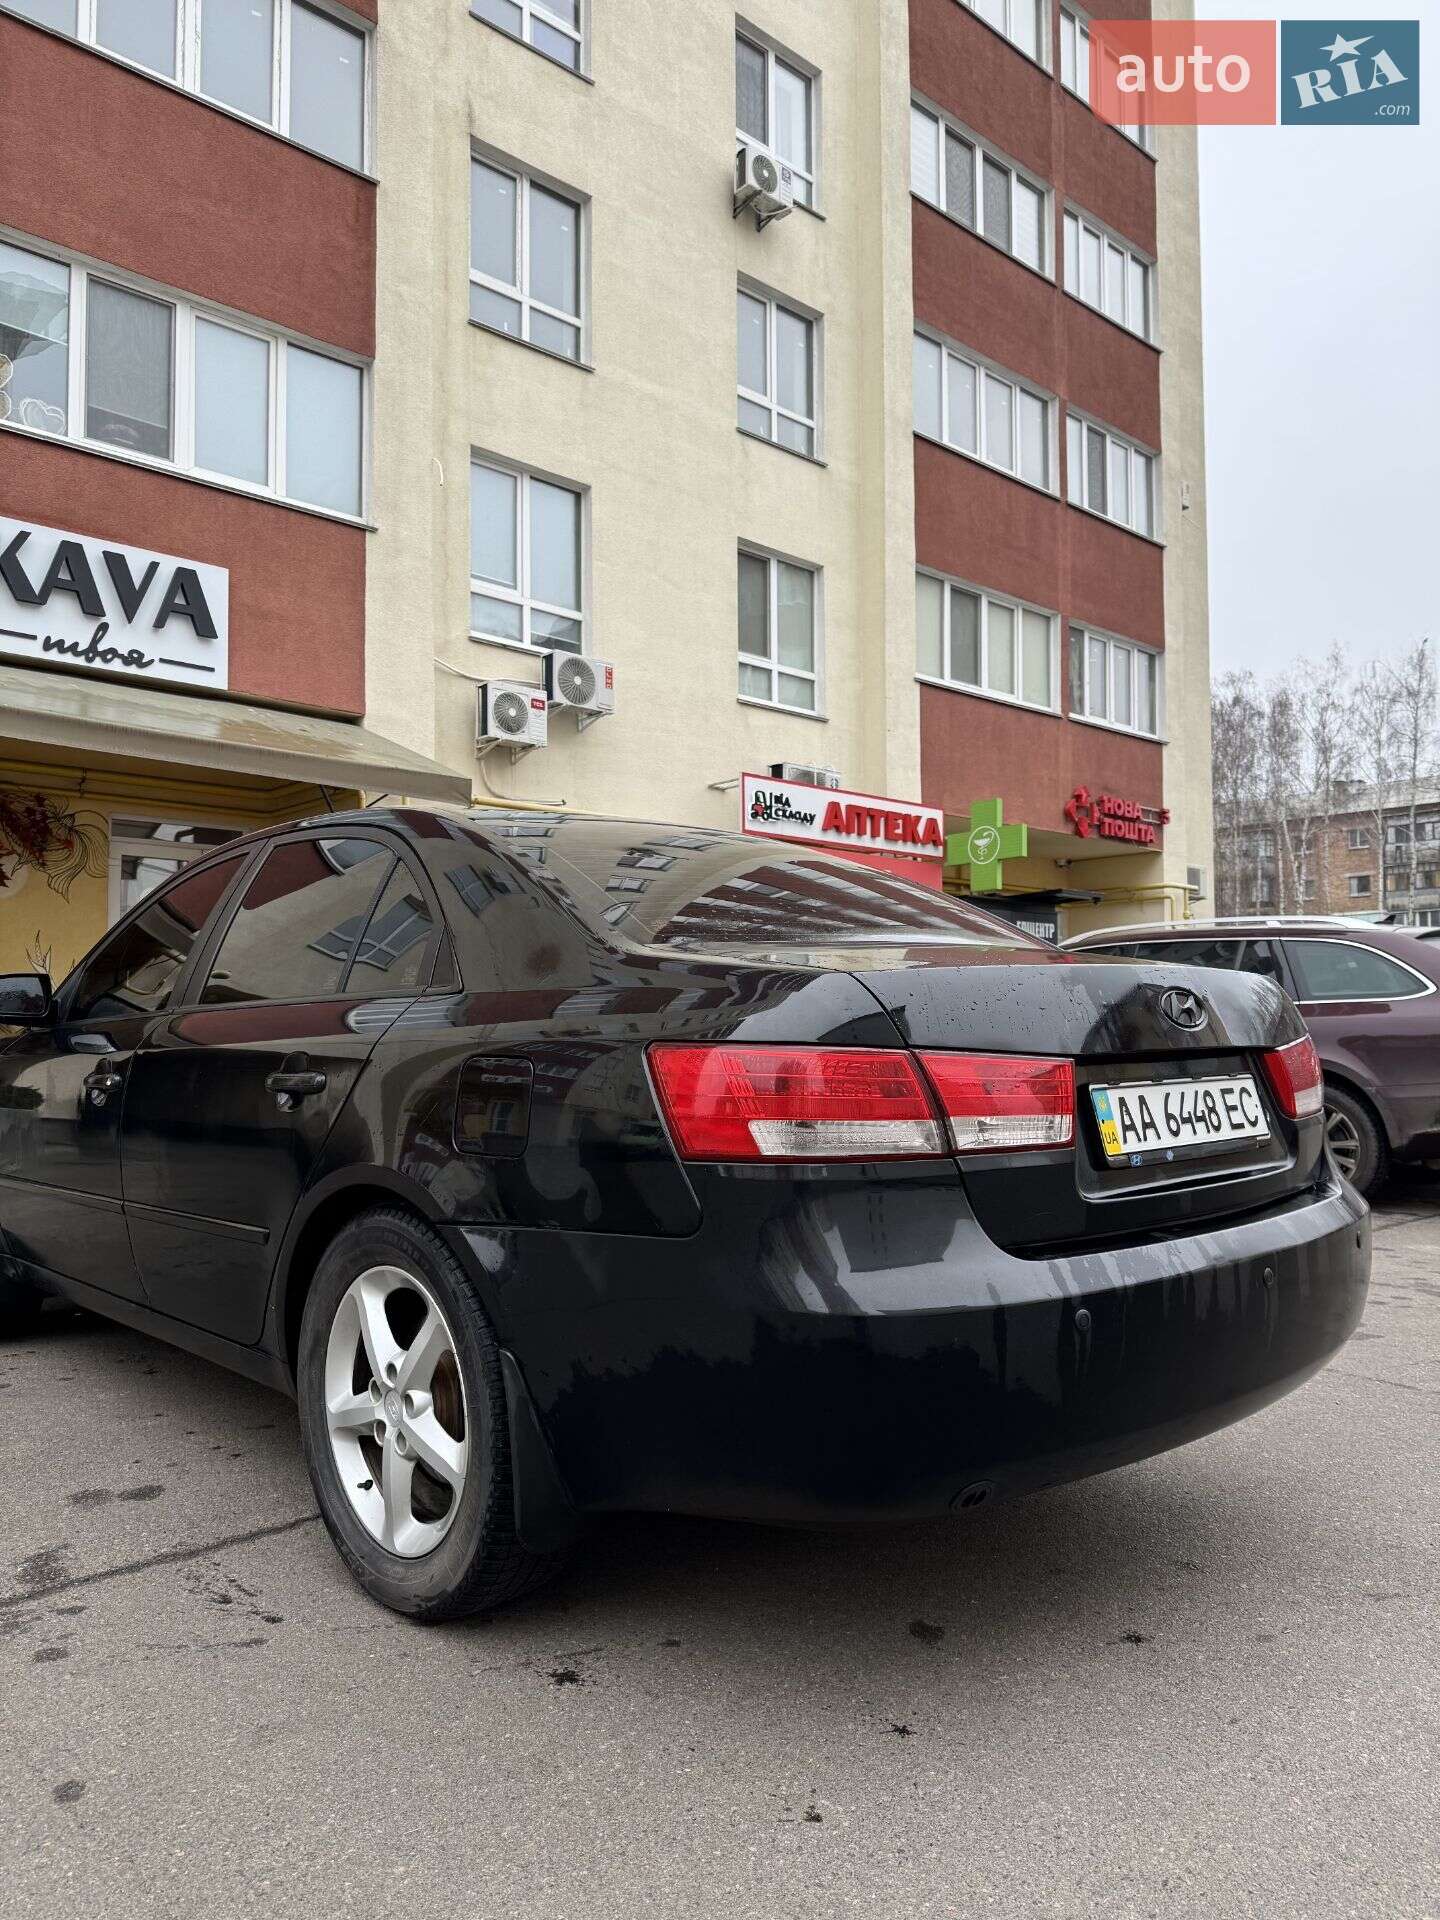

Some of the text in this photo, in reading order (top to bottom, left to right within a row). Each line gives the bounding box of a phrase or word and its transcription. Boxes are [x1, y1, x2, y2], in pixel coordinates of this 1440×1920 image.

[1100, 795, 1142, 819] НОВА
[821, 801, 943, 847] АПТЕКА
[1100, 818, 1156, 844] ПОШТА
[1118, 1086, 1259, 1144] AA 6448 EC
[1104, 1131, 1119, 1145] UA
